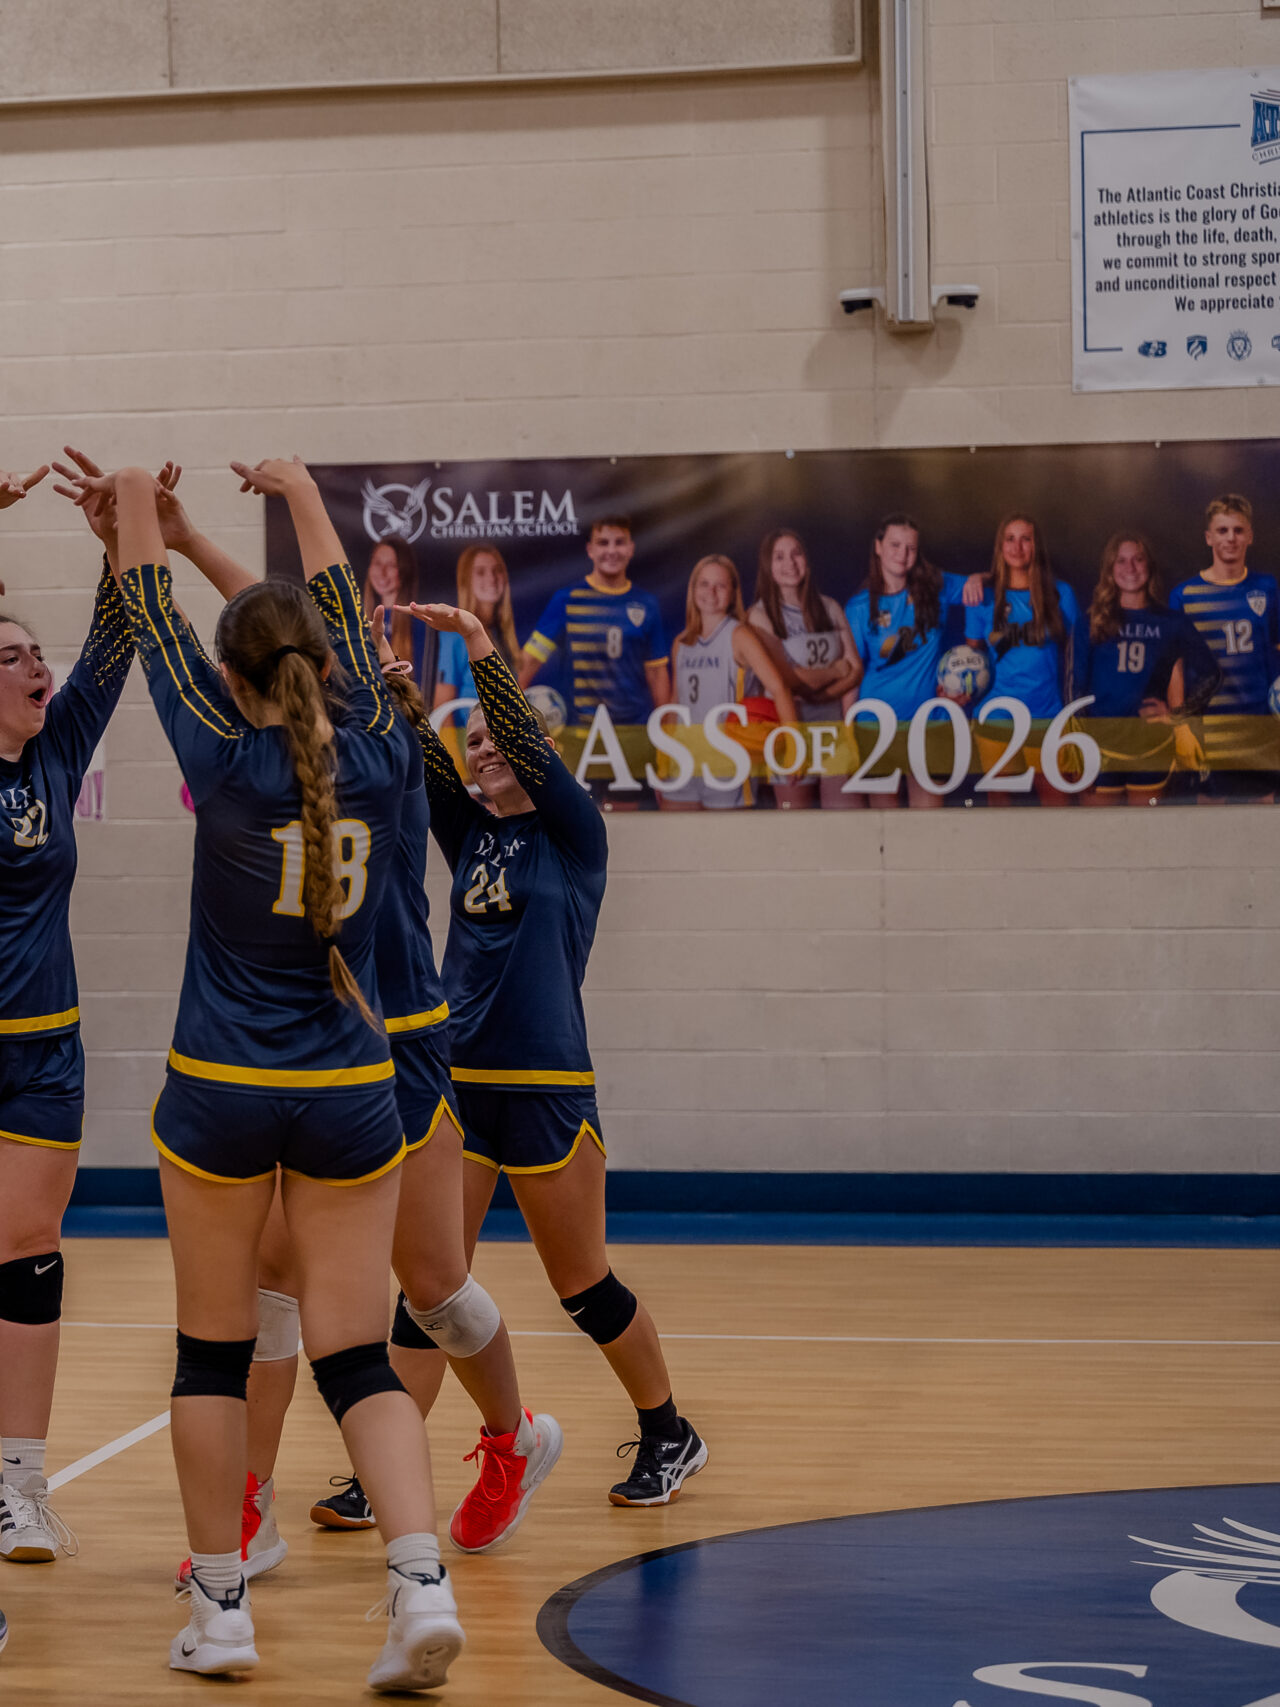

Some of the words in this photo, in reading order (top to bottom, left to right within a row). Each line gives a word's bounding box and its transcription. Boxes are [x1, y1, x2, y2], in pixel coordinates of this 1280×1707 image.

[1098, 187, 1121, 204] The
[1127, 185, 1182, 203] Atlantic
[1186, 184, 1225, 201] Coast
[1094, 208, 1154, 226] athletics
[1159, 207, 1170, 223] is
[1175, 207, 1197, 223] the
[1202, 206, 1237, 225] glory
[1242, 204, 1255, 221] of
[1117, 229, 1170, 249] through
[1176, 228, 1198, 245] the
[1203, 227, 1229, 245] life,
[1234, 225, 1277, 244] death,
[1103, 258, 1121, 270] we
[1126, 252, 1179, 269] commit
[1184, 252, 1197, 267] to
[1202, 250, 1246, 268] strong
[1095, 276, 1120, 293] and
[1125, 271, 1220, 292] unconditional
[1225, 271, 1276, 290] respect
[1175, 295, 1195, 312] We
[1200, 293, 1275, 314] appreciate
[432, 486, 578, 527] SALEM
[430, 522, 513, 539] CHRISTIAN
[517, 519, 580, 537] SCHOOL
[606, 626, 623, 659] 8
[806, 637, 830, 667] 32
[1222, 619, 1255, 656] 12
[1117, 640, 1146, 674] 19
[688, 673, 700, 705] 3
[763, 725, 839, 777] OF
[840, 695, 1101, 795] 2026
[271, 818, 372, 921] 18
[464, 863, 513, 914] 24
